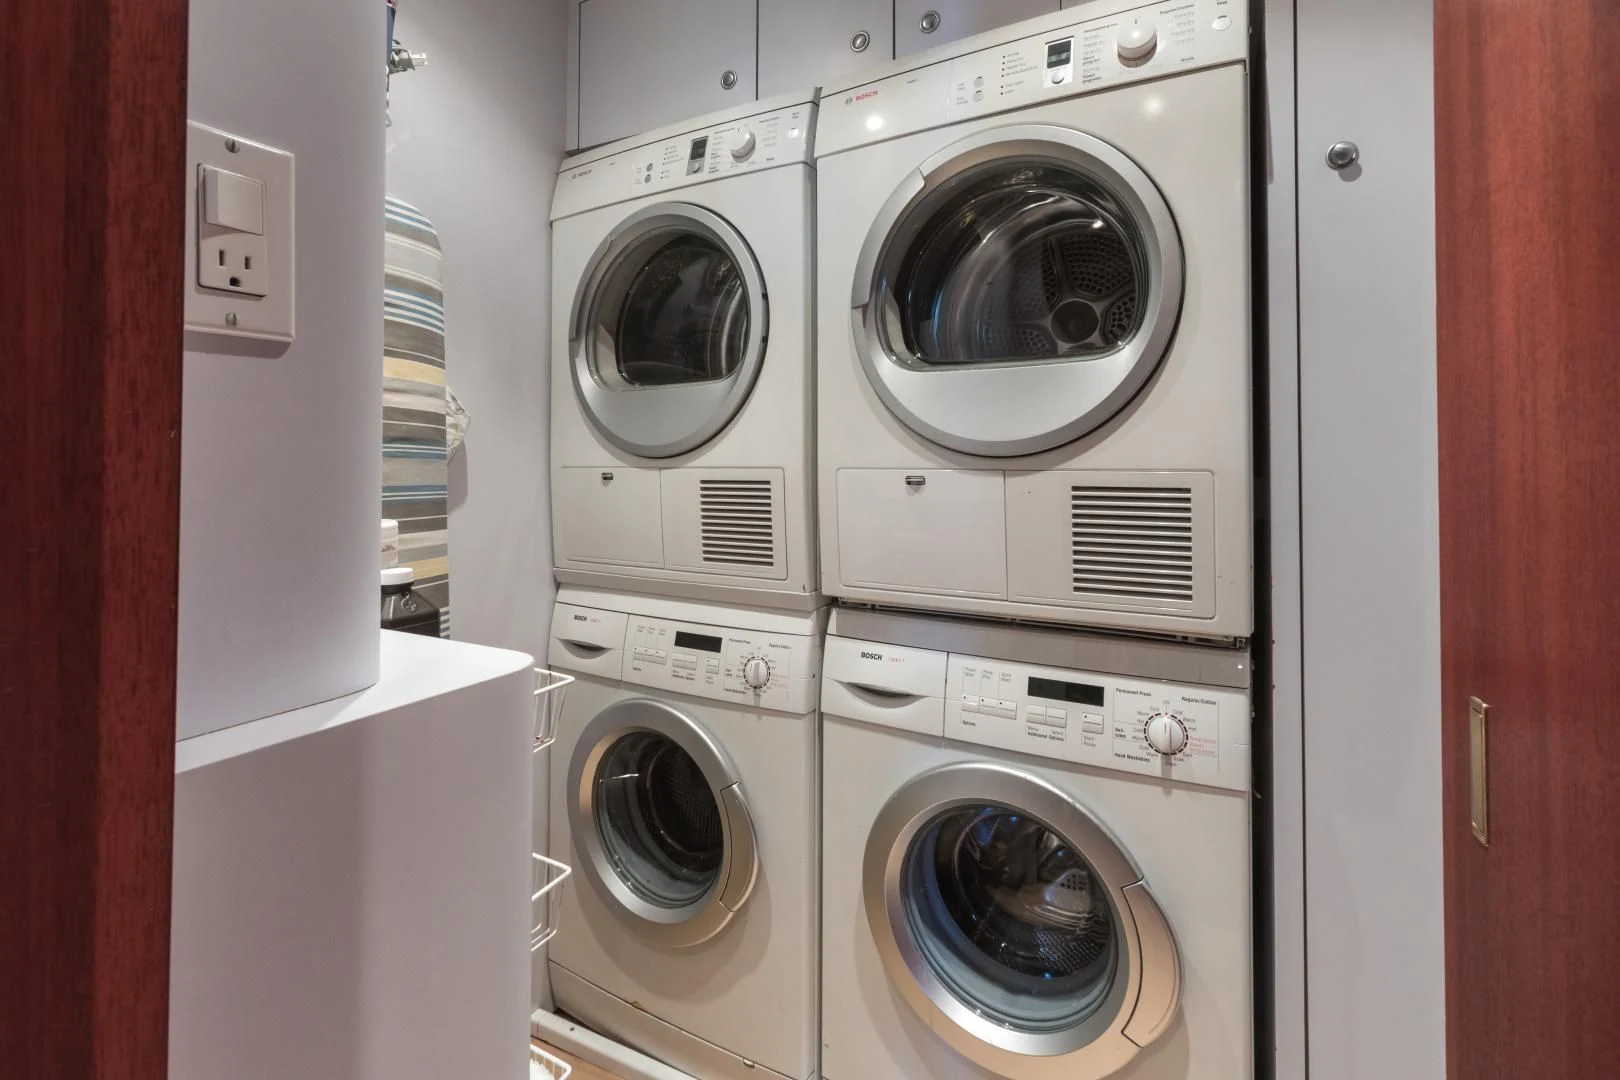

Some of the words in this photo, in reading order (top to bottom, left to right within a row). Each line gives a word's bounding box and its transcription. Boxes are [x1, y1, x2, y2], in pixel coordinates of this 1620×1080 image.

[855, 90, 879, 101] BOSCH
[861, 651, 882, 661] BOSCH
[1115, 687, 1139, 696] Permanent
[1126, 754, 1150, 762] Washables
